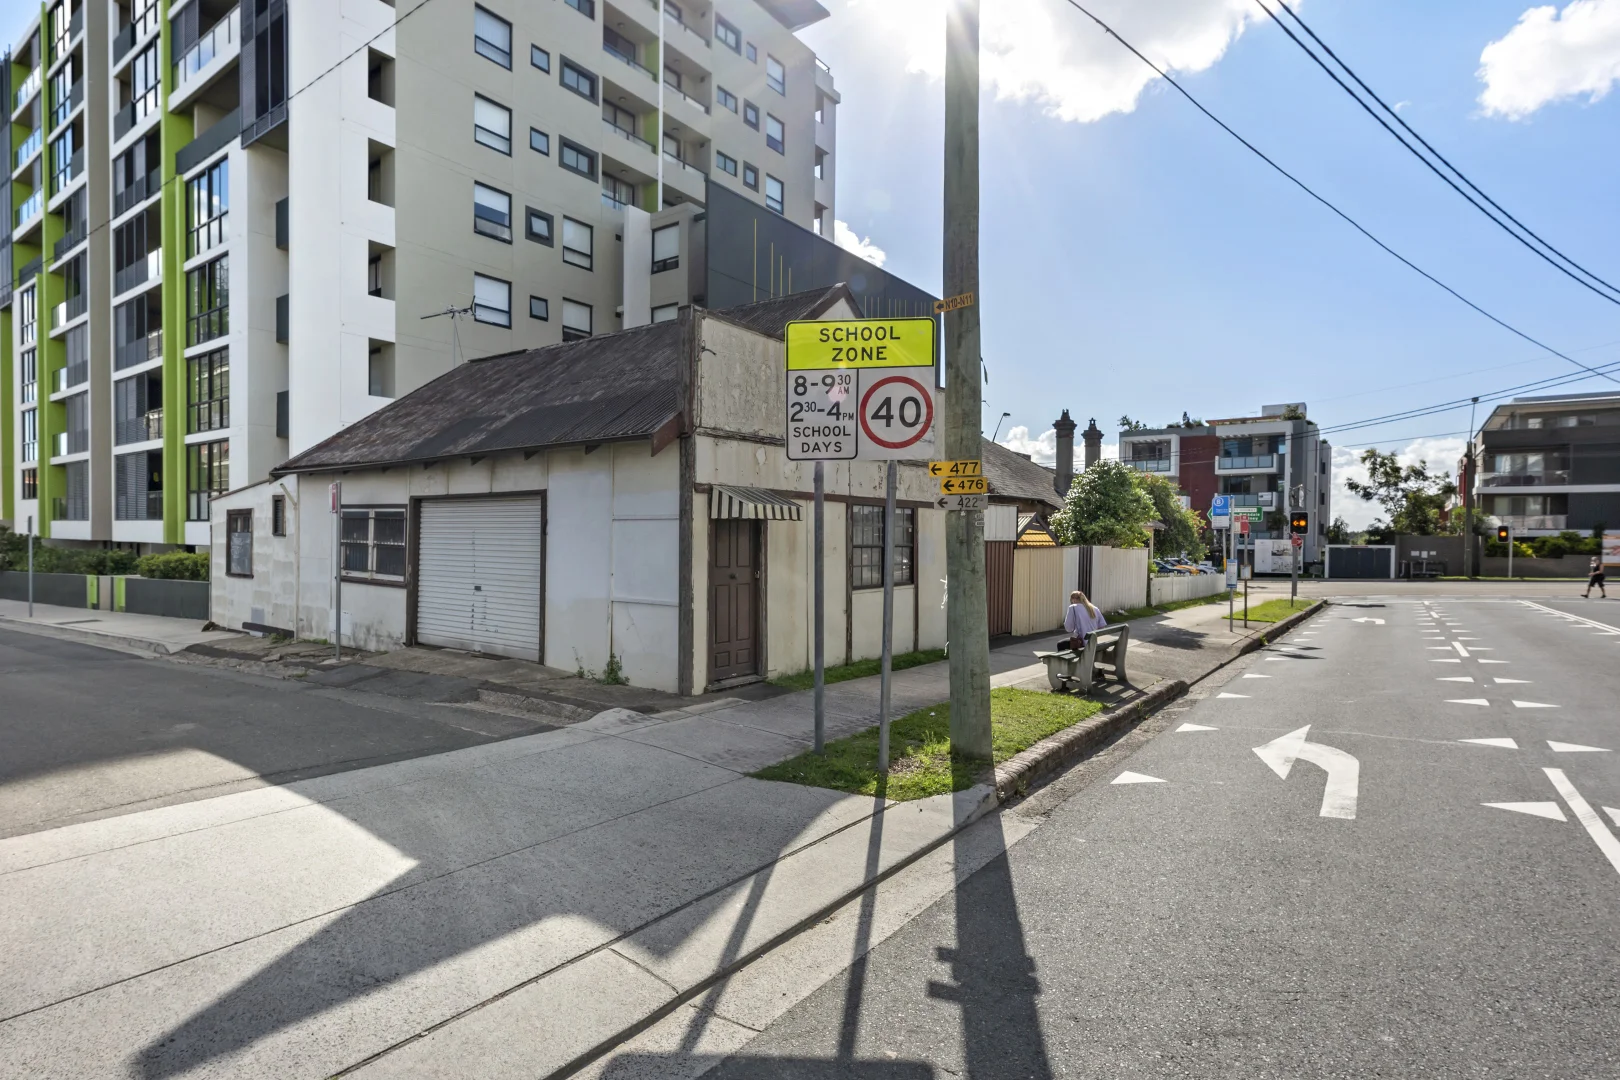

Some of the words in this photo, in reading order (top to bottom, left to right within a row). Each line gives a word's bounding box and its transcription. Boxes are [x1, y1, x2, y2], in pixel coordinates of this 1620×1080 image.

[819, 326, 901, 342] SCHOOL
[831, 346, 887, 362] ZONE
[842, 412, 854, 421] PM
[871, 396, 922, 428] 40
[793, 425, 851, 438] SCHOOL
[801, 442, 842, 453] DAYS
[949, 462, 978, 474] 477
[958, 479, 984, 490] 476
[957, 497, 978, 508] 422
